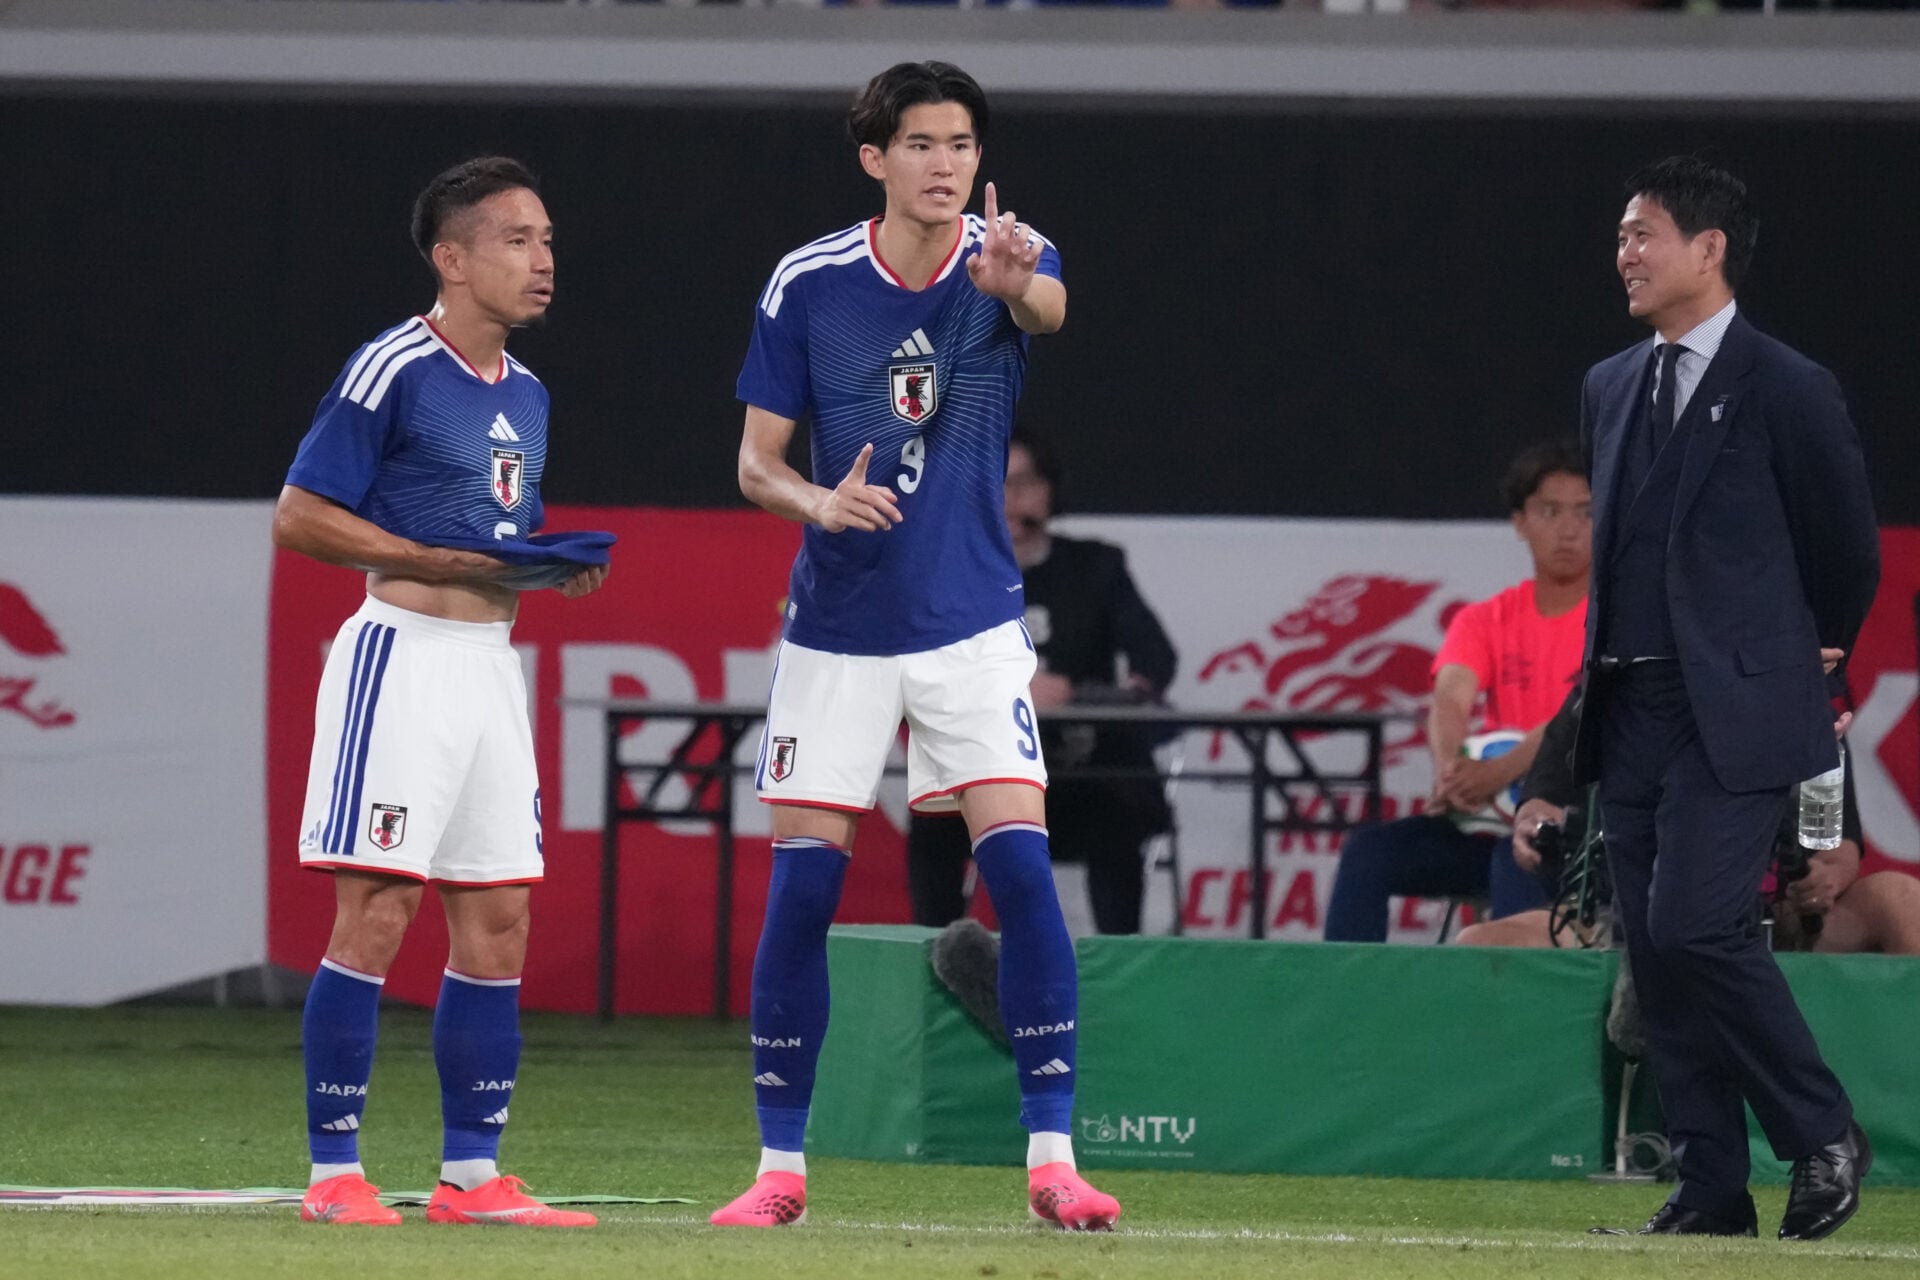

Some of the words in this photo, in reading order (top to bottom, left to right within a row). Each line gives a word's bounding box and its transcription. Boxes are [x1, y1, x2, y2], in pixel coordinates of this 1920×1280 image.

[498, 450, 516, 459] JAPAN
[897, 435, 926, 494] 9
[1012, 697, 1038, 761] 9
[0, 843, 91, 906] GE
[1013, 1019, 1074, 1038] JAPAN
[750, 1033, 801, 1048] APAN
[315, 1081, 369, 1097] JAPA
[471, 1079, 516, 1091] JAP
[1120, 1115, 1196, 1145] NTV
